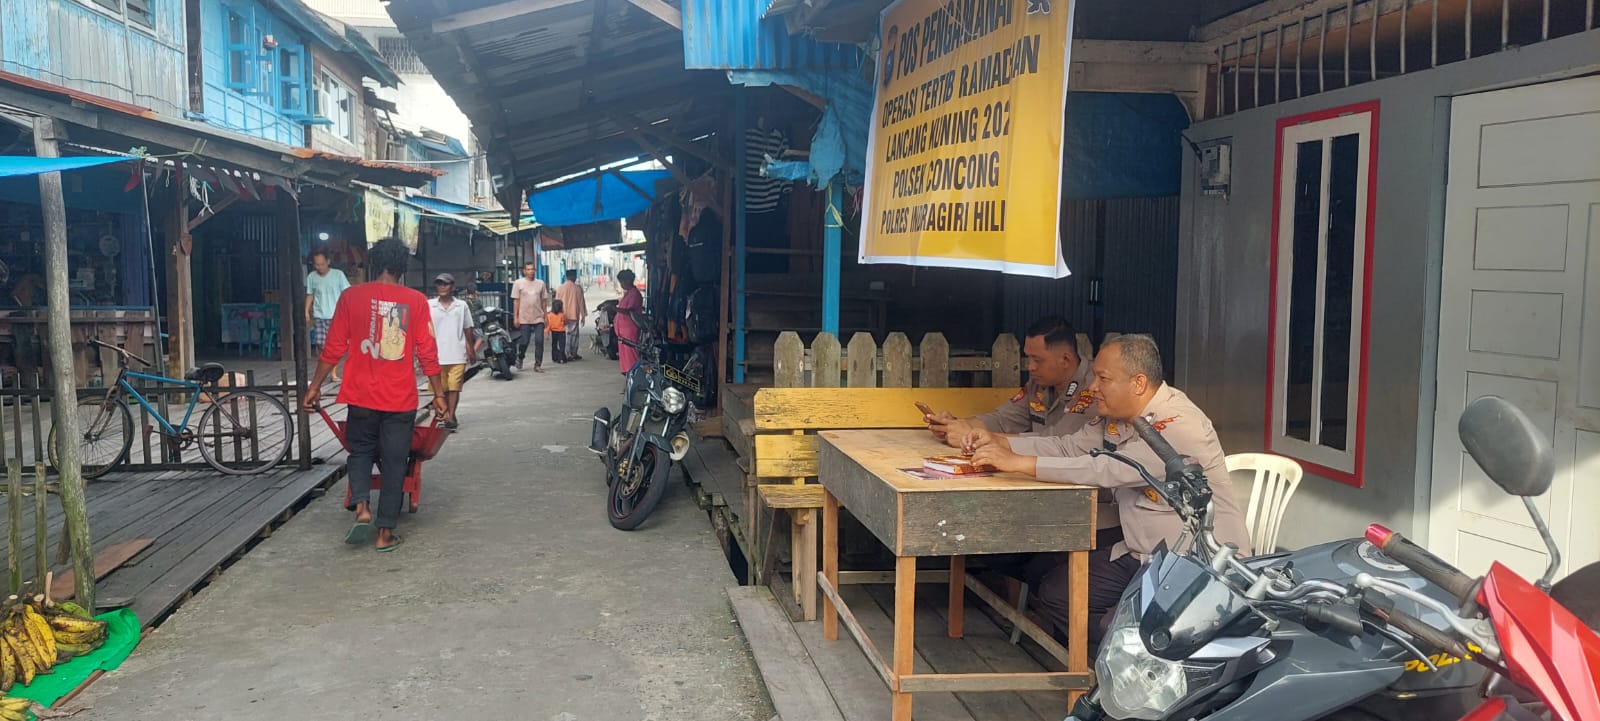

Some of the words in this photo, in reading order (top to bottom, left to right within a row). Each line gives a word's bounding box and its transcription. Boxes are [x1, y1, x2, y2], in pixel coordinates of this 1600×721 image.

[897, 22, 920, 79] POS
[882, 87, 918, 128] OPERASI
[920, 69, 955, 113] TERTIB
[886, 122, 928, 163] LANCANG
[928, 107, 979, 150] KUNING
[892, 163, 927, 199] POLSEK
[926, 151, 1000, 192] CONCONG
[880, 207, 909, 234] POLRES
[360, 338, 380, 360] 2
